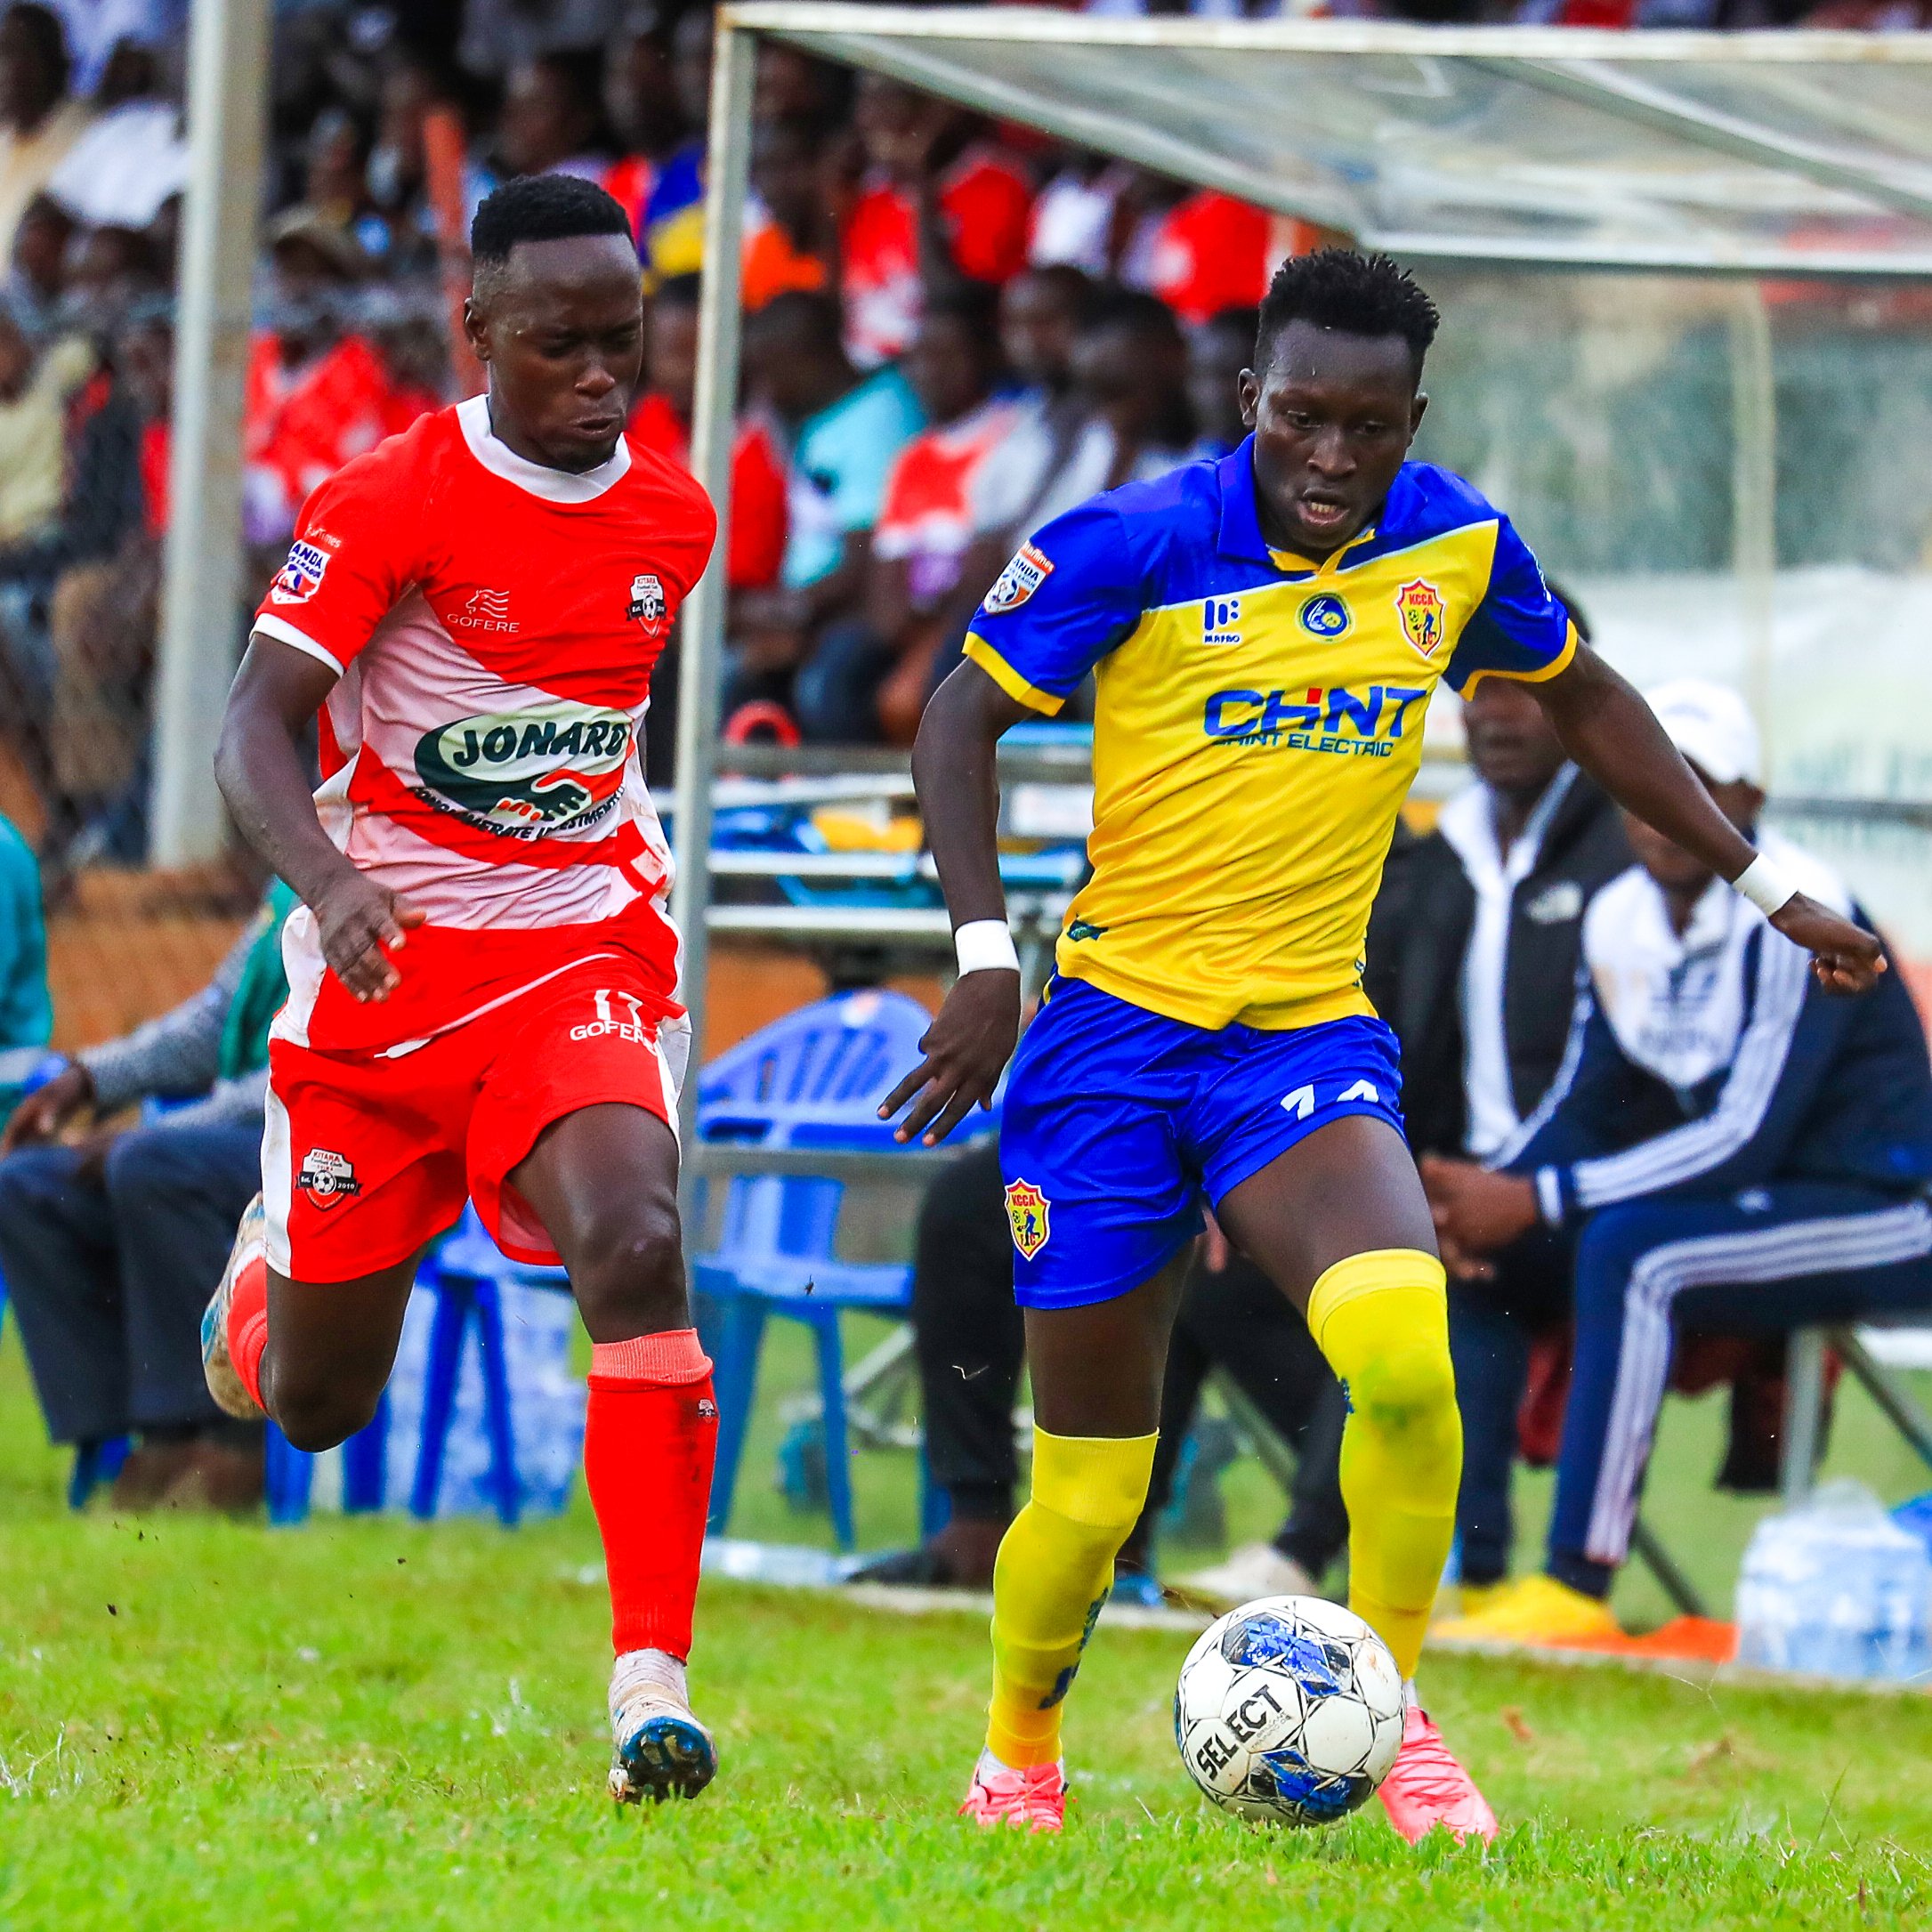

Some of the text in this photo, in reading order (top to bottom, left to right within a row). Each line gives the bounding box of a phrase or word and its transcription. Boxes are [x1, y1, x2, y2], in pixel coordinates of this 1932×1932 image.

[292, 543, 324, 570] ANDA
[1014, 558, 1039, 582] ANDA
[1409, 594, 1434, 605] KCCA
[447, 613, 521, 633] GOFERE
[453, 720, 627, 768] JONARD
[1288, 733, 1394, 757] ELECTRIC
[313, 1151, 341, 1162] KITARA
[1011, 1194, 1036, 1207] KCCA
[1197, 1684, 1282, 1782] SELECT
